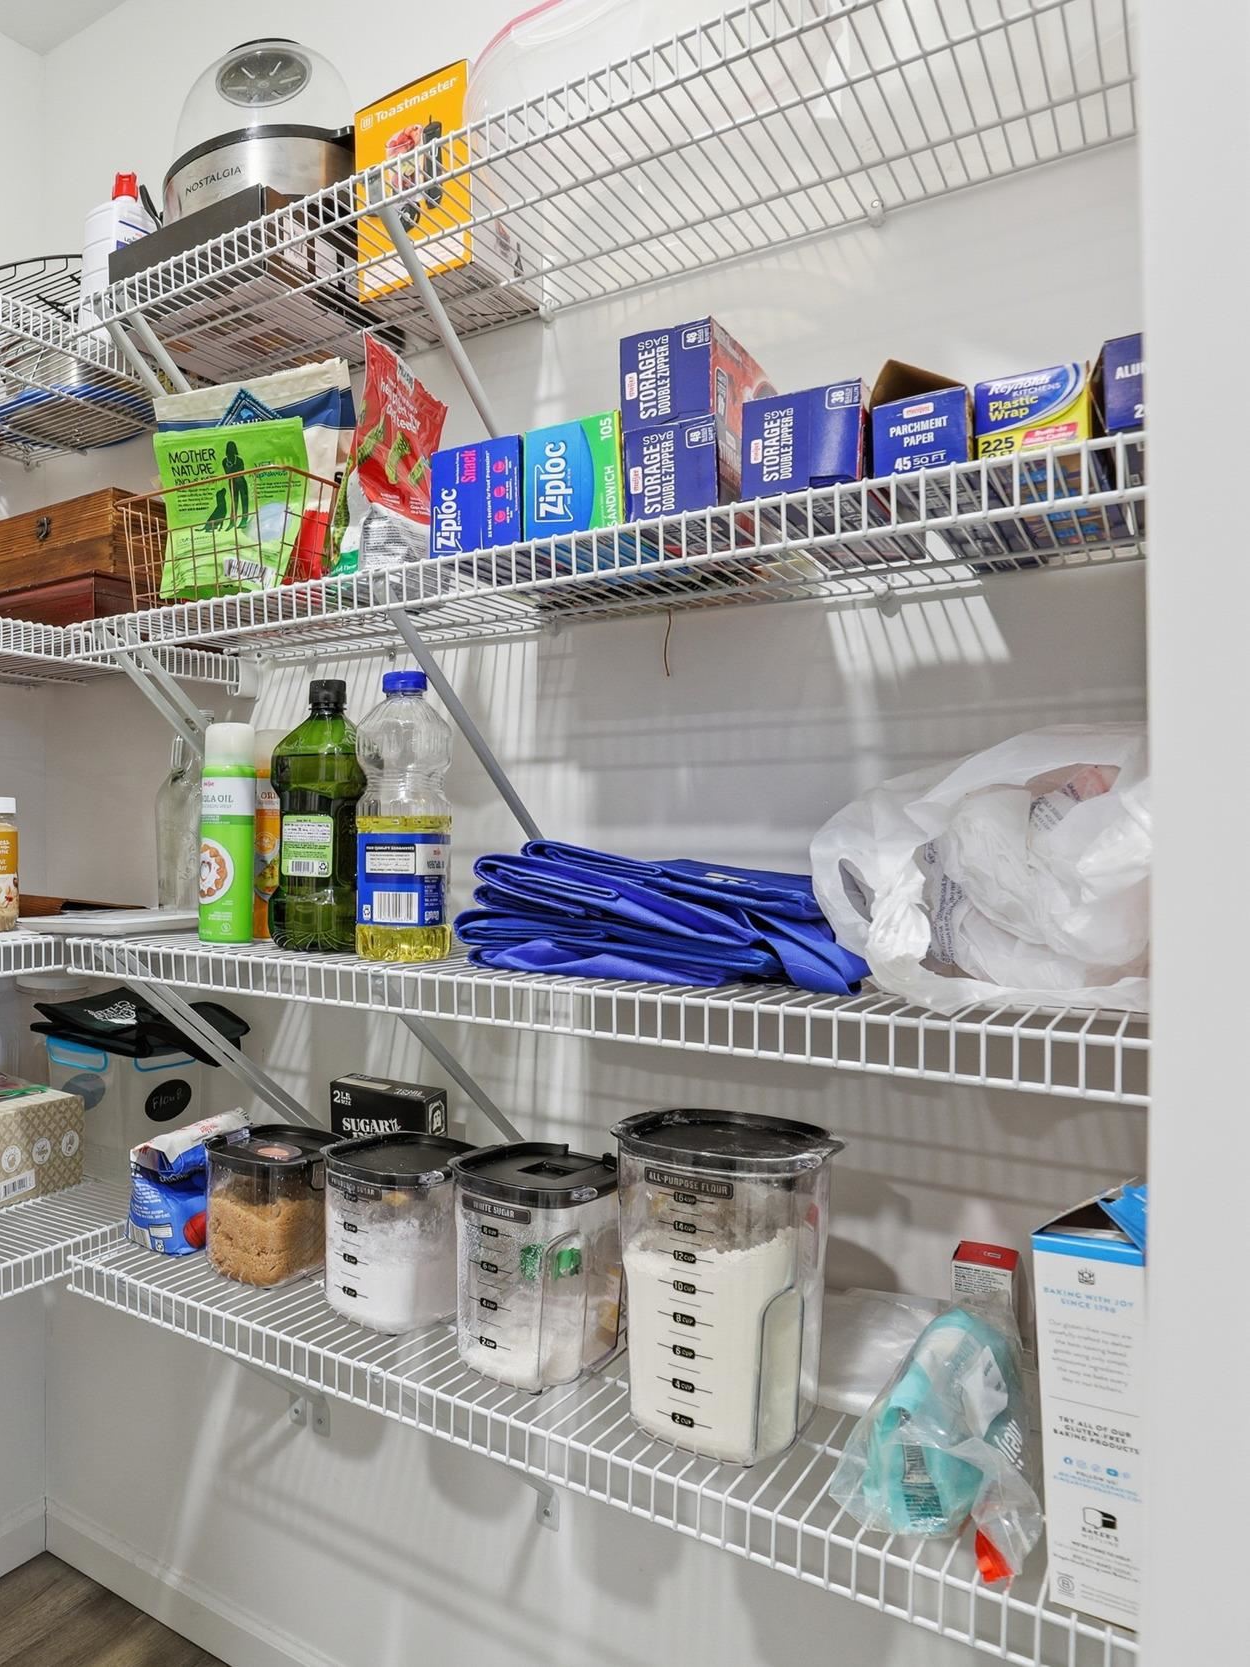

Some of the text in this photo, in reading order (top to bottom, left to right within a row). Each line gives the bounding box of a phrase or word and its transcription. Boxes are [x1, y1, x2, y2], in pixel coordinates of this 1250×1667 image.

[375, 77, 457, 122] Toastmaster
[185, 166, 241, 196] NOSTALGIA
[638, 348, 657, 419] STORAGE
[656, 344, 671, 416] DOUBLE ZIPPER
[988, 374, 1052, 396] Reynolds
[1012, 382, 1061, 398] KITCHENS
[989, 395, 1039, 413] Plastic
[989, 407, 1030, 422] Wrap
[600, 417, 613, 441] 105
[889, 416, 948, 437] PARCHMENT
[780, 416, 793, 480] DOUBLE ZIPPER
[903, 432, 934, 447] PAPER
[981, 436, 1015, 454] 225
[168, 448, 216, 464] MOTHER
[763, 419, 780, 482] STORAGE
[172, 462, 215, 477] NATURE
[461, 449, 477, 483] Snack
[894, 453, 946, 471] 45 SQ FT
[539, 440, 573, 518] Ziploc
[643, 443, 661, 514] STORAGE
[661, 440, 675, 511] DOUBLE ZIPPER
[436, 488, 462, 549] Ziploc
[217, 794, 234, 803] OIL
[333, 1090, 341, 1103] 2
[342, 1117, 391, 1132] SUGAR
[649, 1172, 728, 1194] ALL-PURPOSE FLOUR
[675, 1193, 684, 1202] 16
[473, 1201, 515, 1218] WHITE SUGAR
[675, 1221, 684, 1230] 14
[675, 1251, 684, 1260] 12
[674, 1281, 683, 1290] 10
[1043, 1287, 1134, 1308] BAKING WITH JOY
[1061, 1298, 1090, 1309] SINCE
[676, 1314, 681, 1322] 8
[675, 1346, 681, 1354] 6
[675, 1380, 680, 1389] 4
[674, 1415, 680, 1424] 2
[1059, 1415, 1074, 1423] TRY
[1077, 1421, 1093, 1430] ALL
[1111, 1429, 1131, 1438] OUR
[994, 1419, 1025, 1471] meij
[1053, 1428, 1140, 1455] BAKING PRODUCTS
